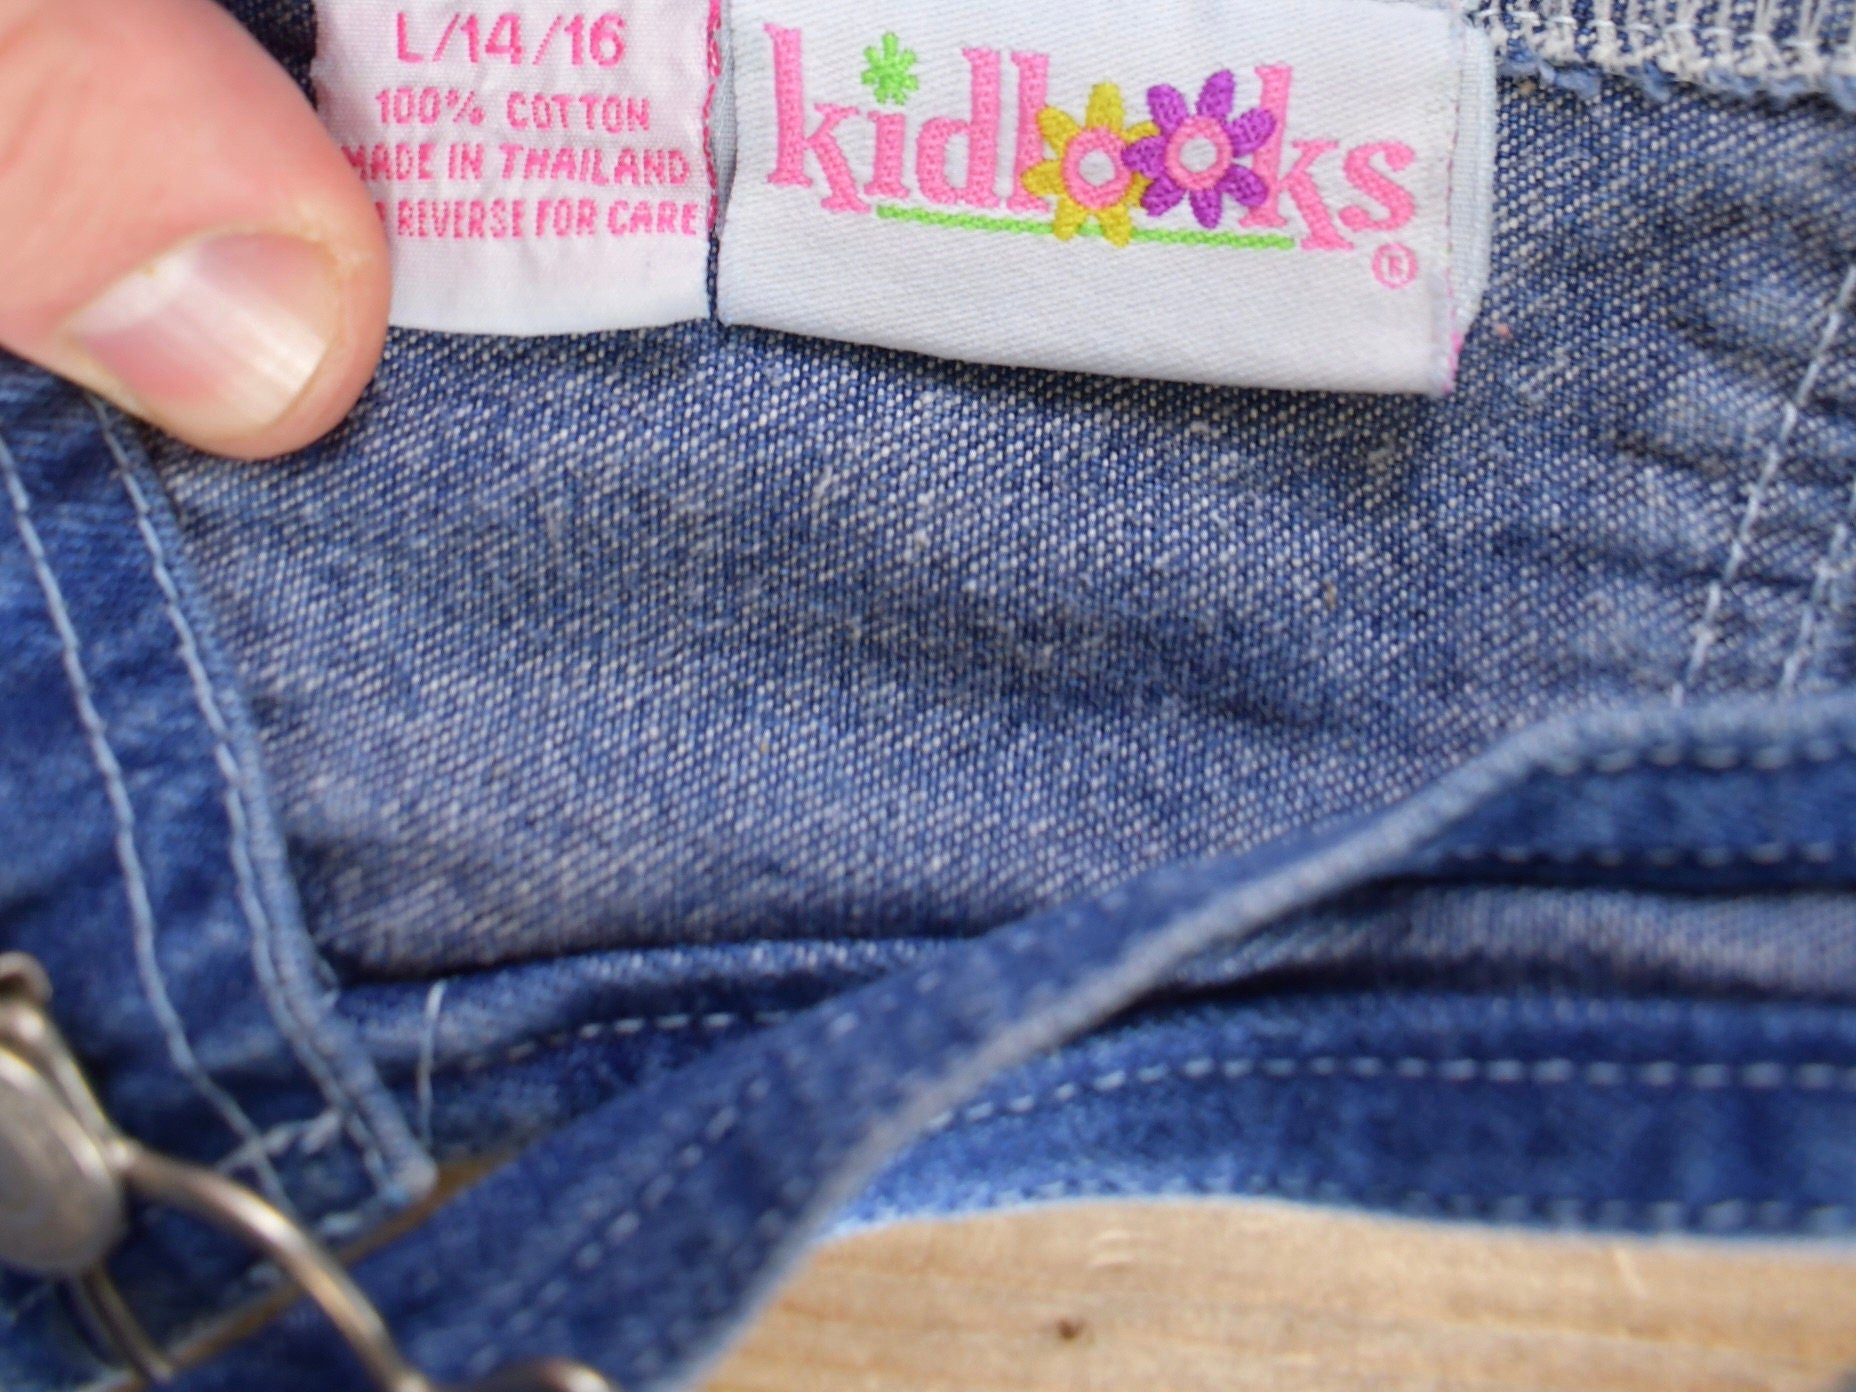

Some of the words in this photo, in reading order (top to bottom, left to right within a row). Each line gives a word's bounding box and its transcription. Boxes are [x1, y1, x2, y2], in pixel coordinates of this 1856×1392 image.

[396, 11, 628, 66] L/14/16
[376, 86, 484, 125] 100%
[506, 92, 651, 133] COTTON
[448, 143, 484, 180] IN
[500, 143, 692, 186] THAILAND
[398, 199, 525, 239] REVERSE
[535, 198, 598, 238] FOR
[607, 200, 699, 237] CARE
